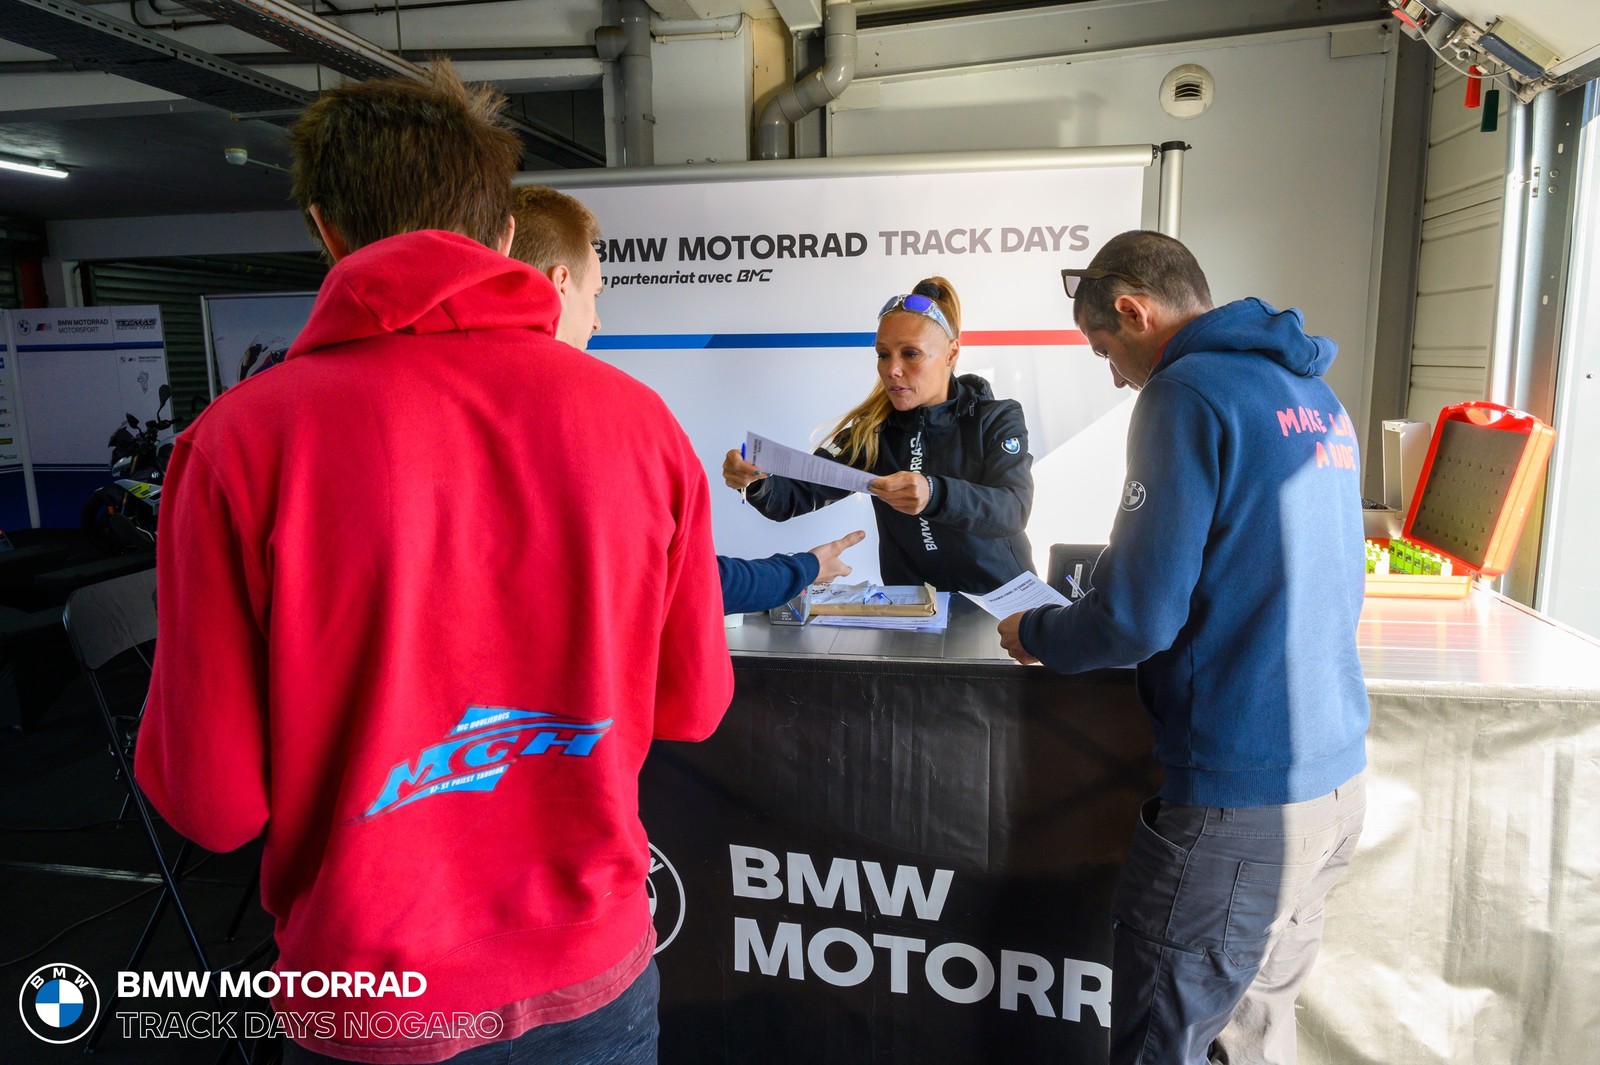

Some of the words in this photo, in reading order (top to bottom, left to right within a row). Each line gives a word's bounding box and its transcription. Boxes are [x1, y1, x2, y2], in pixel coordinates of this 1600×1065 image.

[591, 237, 668, 263] BMW
[678, 231, 868, 262] MOTORRAD
[878, 227, 994, 256] TRACK
[1000, 225, 1091, 253] DAYS
[611, 270, 695, 288] partenariat
[697, 271, 732, 284] avec
[736, 268, 773, 283] BMC
[1276, 405, 1328, 437] MAKE
[1328, 413, 1357, 444] LI
[1316, 441, 1330, 470] A
[919, 516, 938, 551] BMW
[364, 719, 614, 816] MCH
[441, 783, 450, 791] ST
[451, 775, 475, 787] PRIEST
[728, 844, 955, 921] BMW
[733, 916, 1112, 1028] MOTORR
